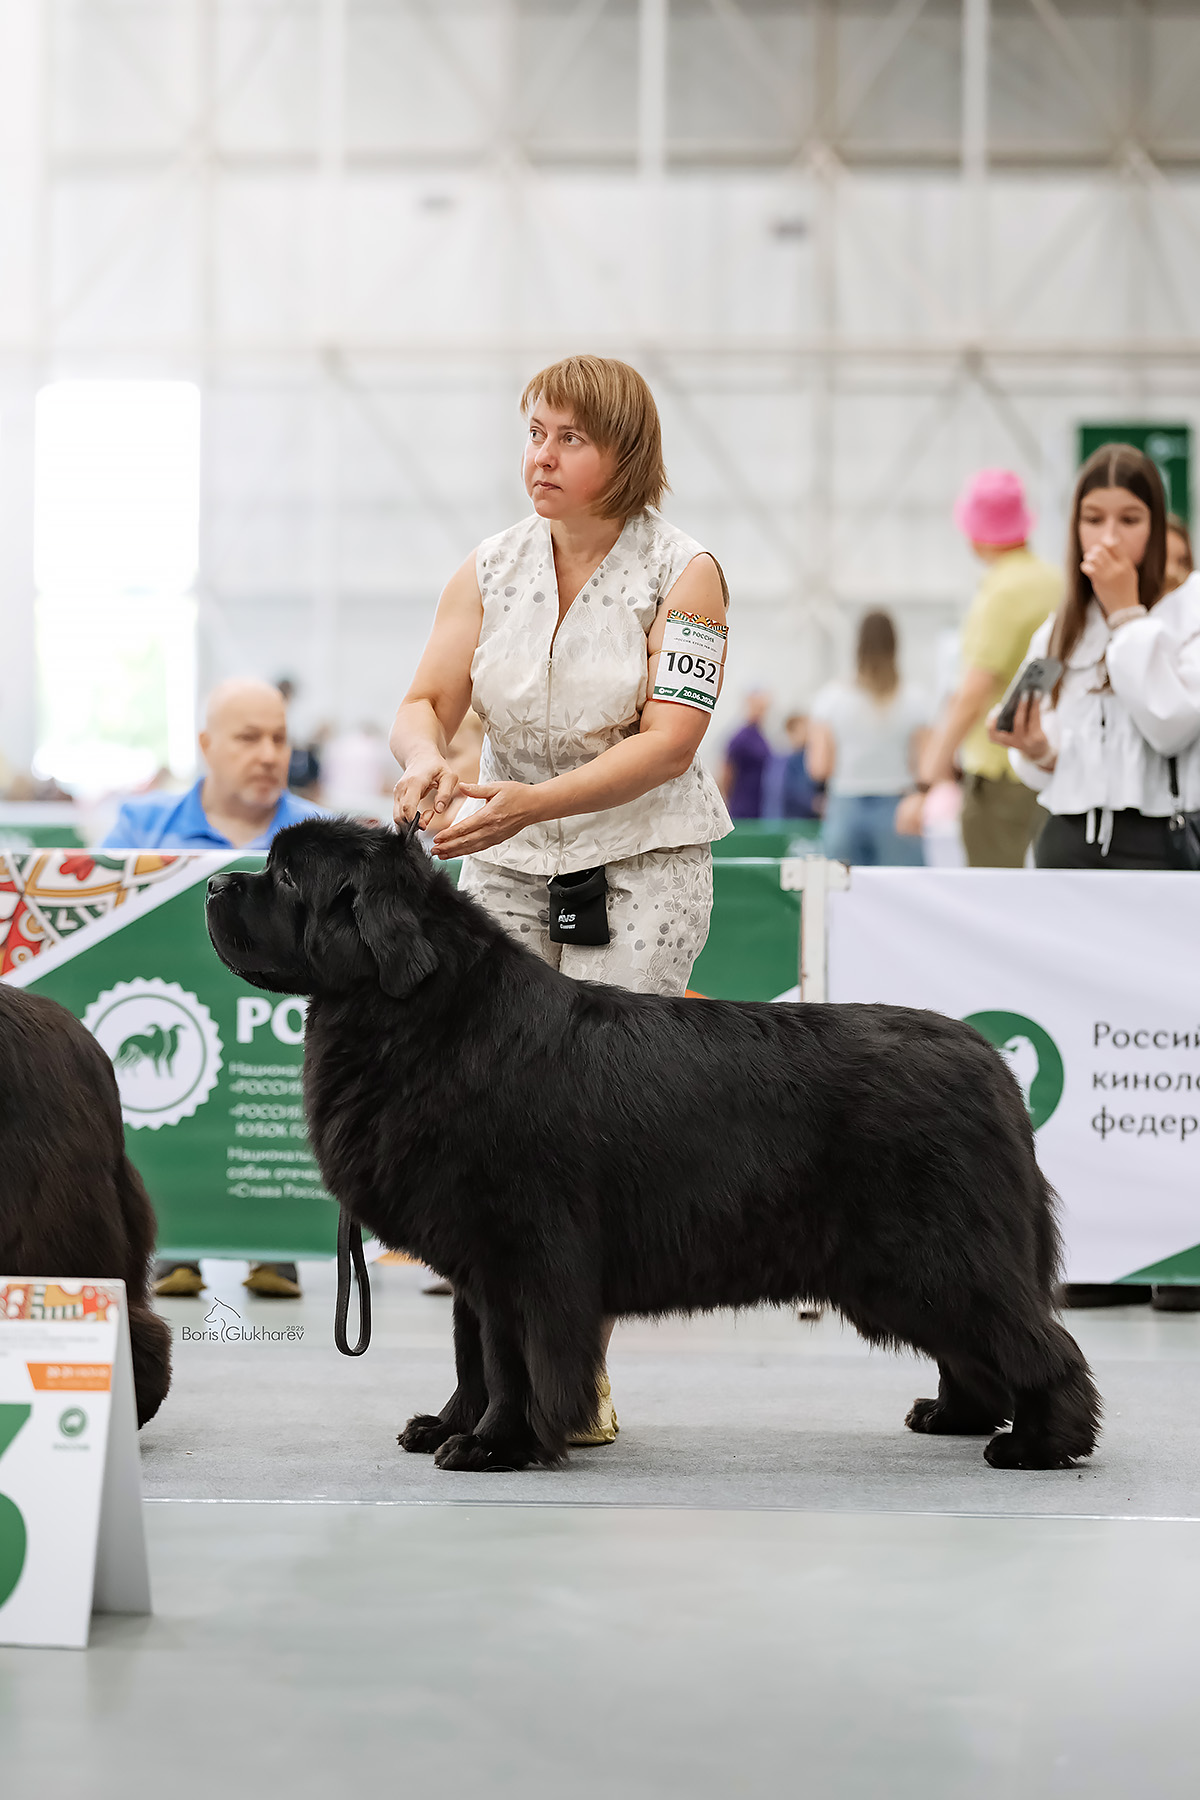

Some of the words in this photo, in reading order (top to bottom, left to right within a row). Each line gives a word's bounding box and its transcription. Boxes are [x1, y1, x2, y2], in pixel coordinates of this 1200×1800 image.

[667, 652, 717, 684] 1052
[236, 996, 308, 1045] РО
[1093, 1071, 1200, 1092] кинол
[1091, 1105, 1199, 1141] федер
